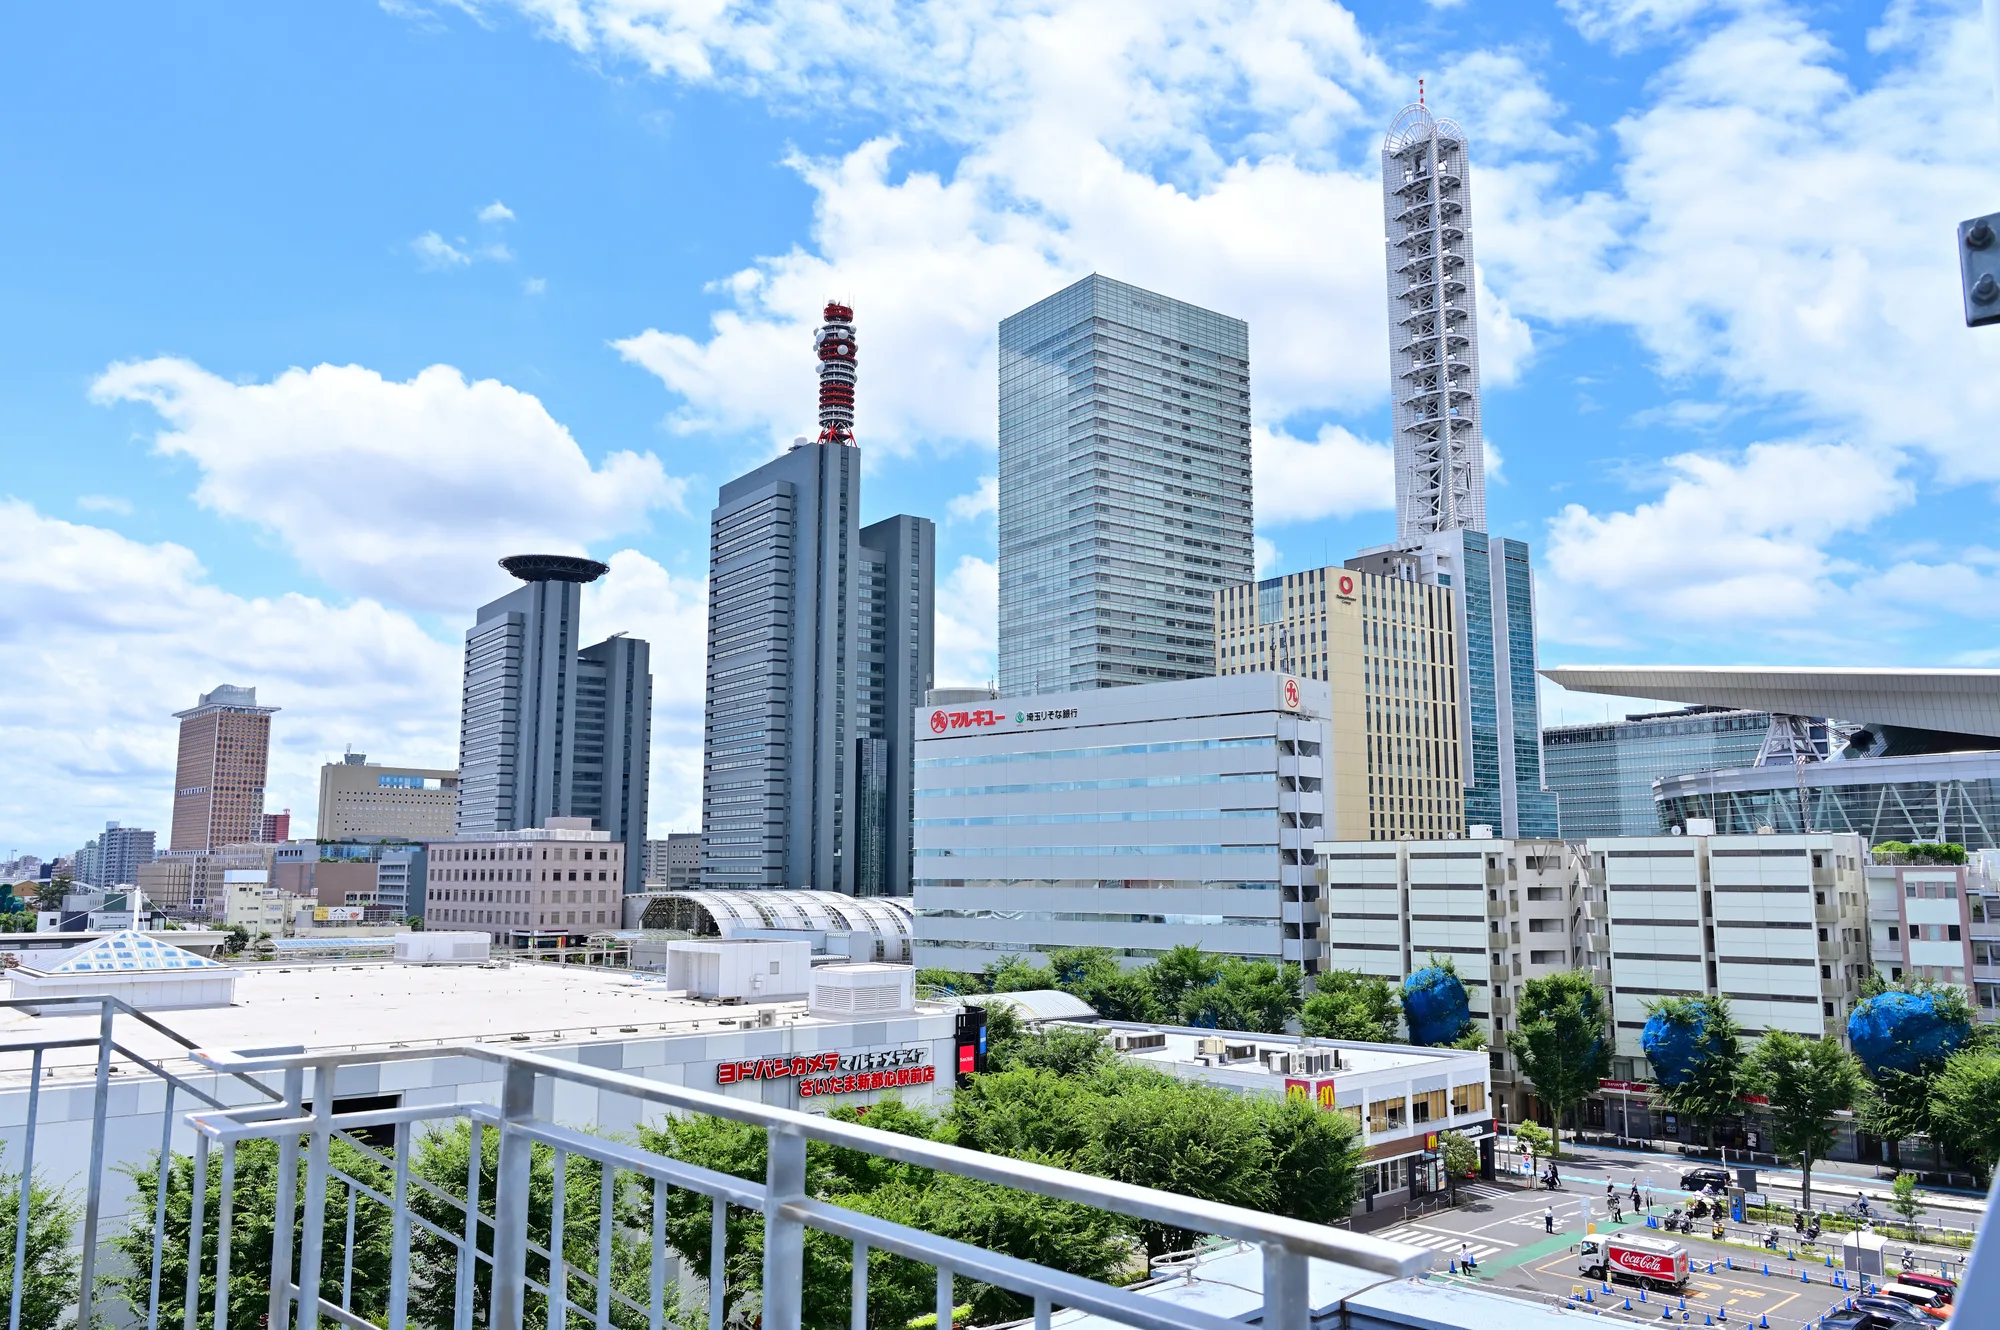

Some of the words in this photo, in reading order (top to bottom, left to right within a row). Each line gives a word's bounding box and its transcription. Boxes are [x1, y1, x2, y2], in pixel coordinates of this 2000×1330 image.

[1026, 708, 1078, 722] 埼玉りそな銀行
[799, 1066, 935, 1097] さいたま新都心駅前店
[1620, 1251, 1663, 1271] Coca-Cola
